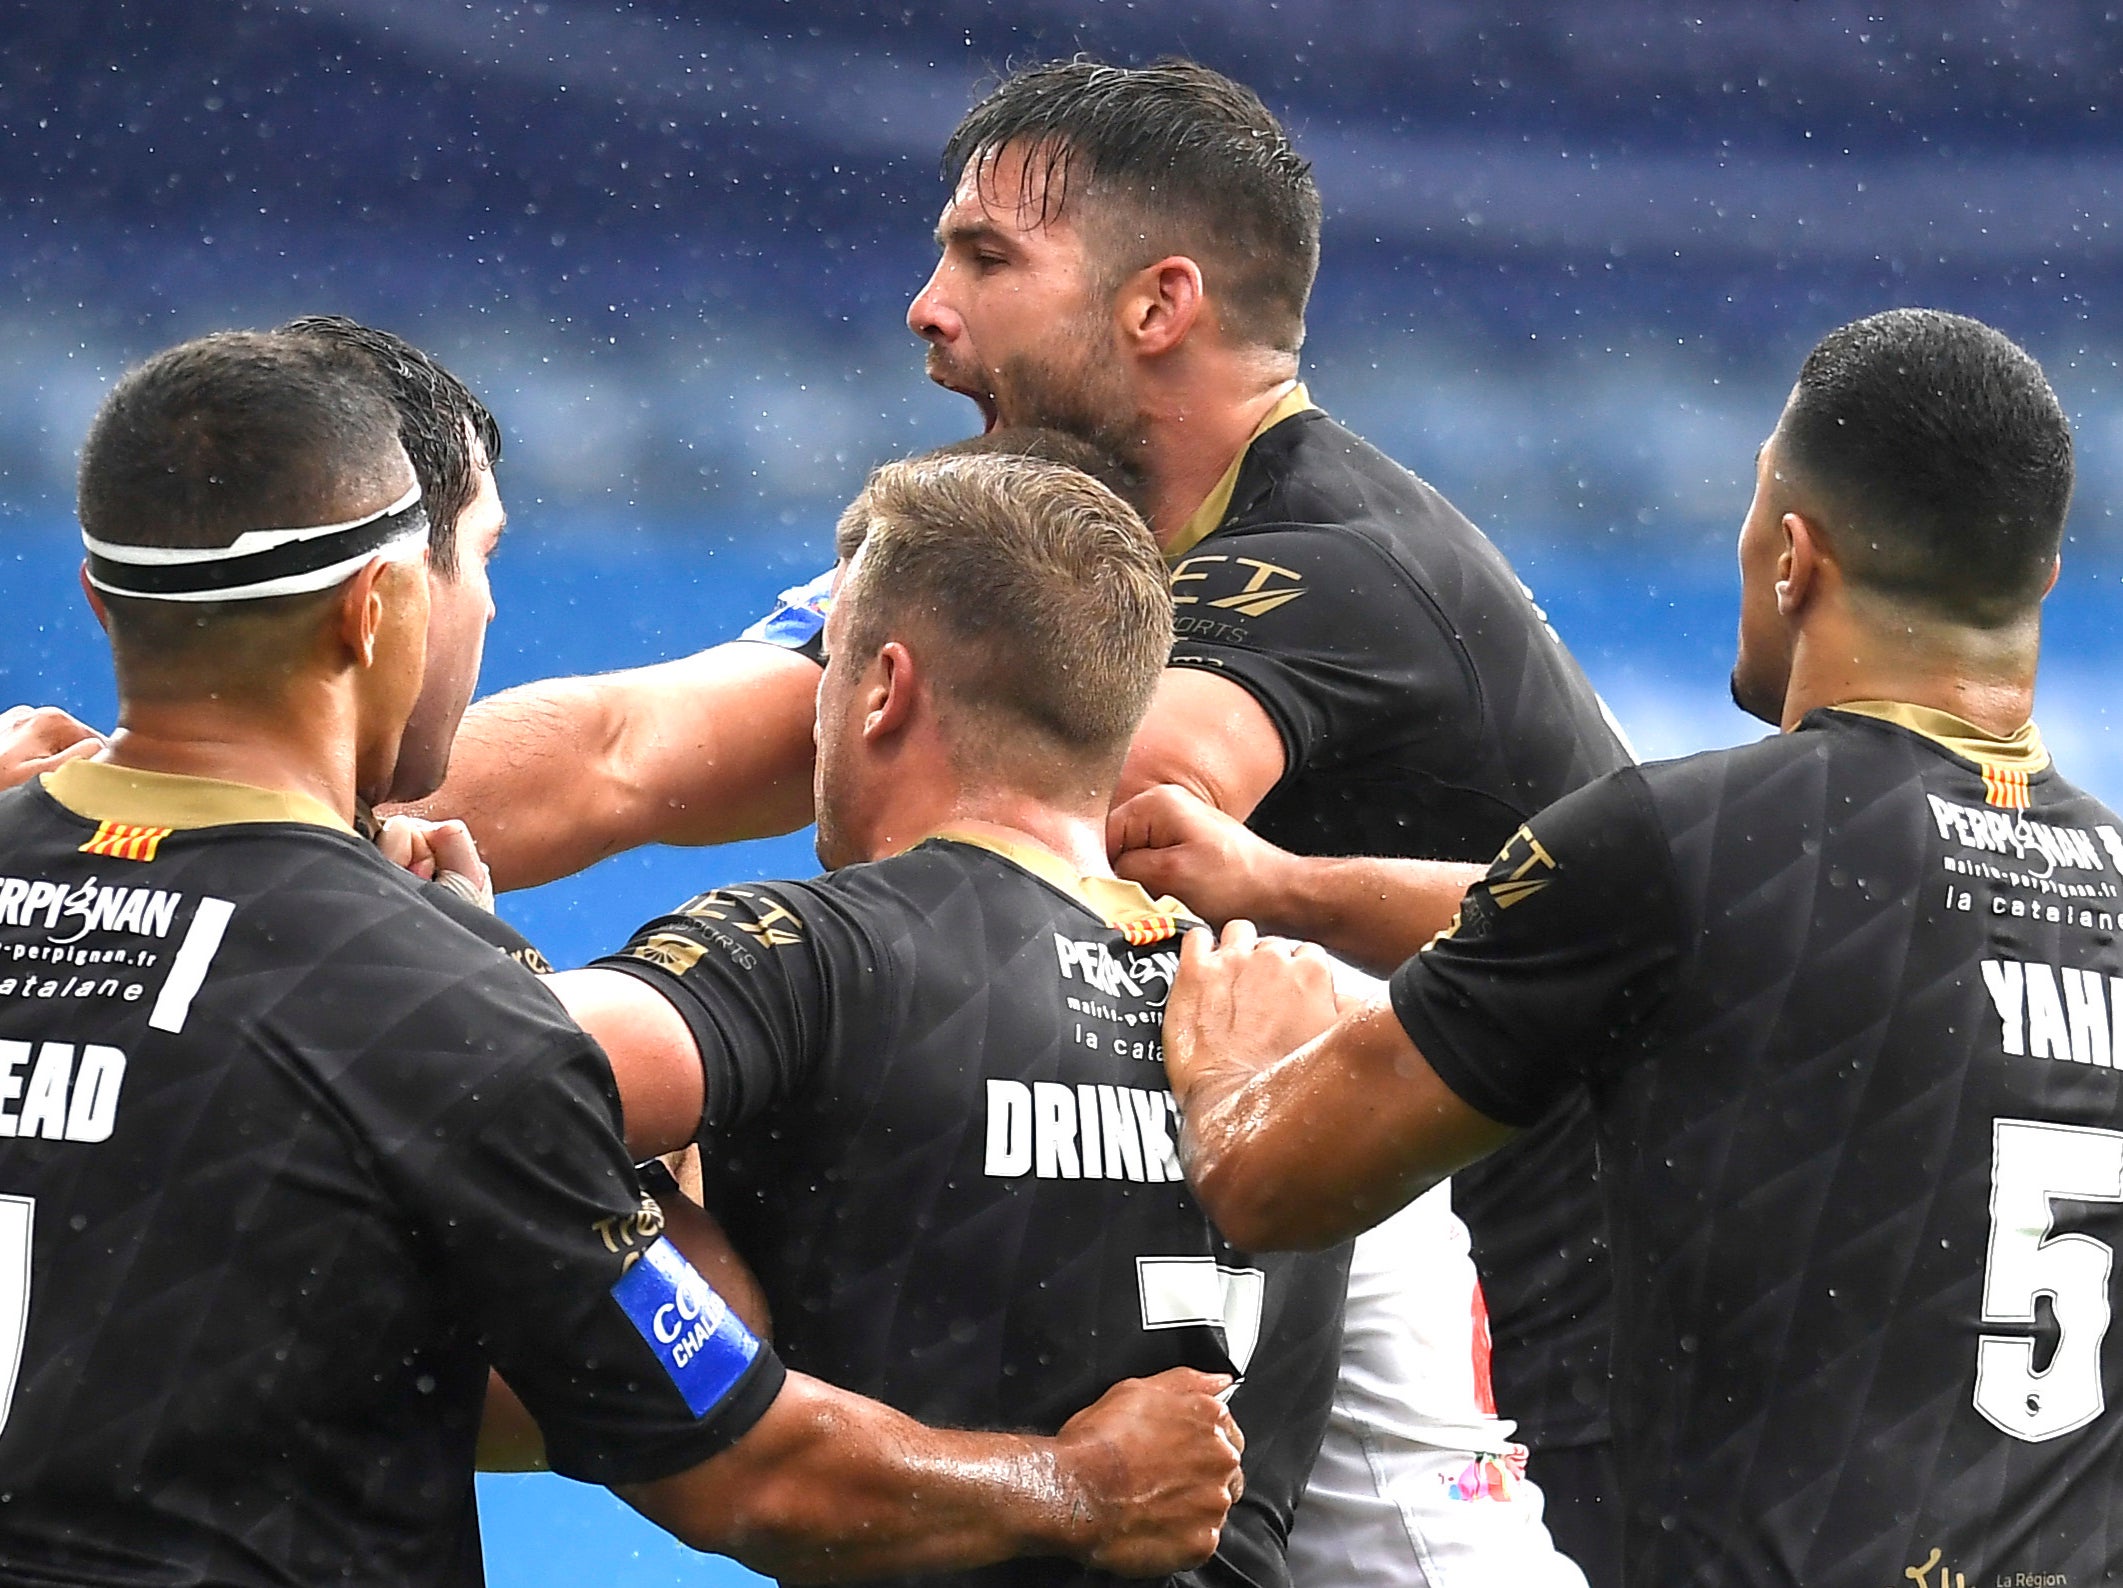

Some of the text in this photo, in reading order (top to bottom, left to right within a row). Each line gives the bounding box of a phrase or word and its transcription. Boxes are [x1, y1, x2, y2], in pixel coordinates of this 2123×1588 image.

[1173, 616, 1249, 643] ORTS
[0, 876, 181, 944] RPIGNAN
[1946, 885, 1972, 911] la
[0, 943, 157, 967] -perpignan.fr
[1075, 1023, 1099, 1050] la
[1972, 1117, 2123, 1443] 5
[1996, 1572, 2067, 1588] La Région
